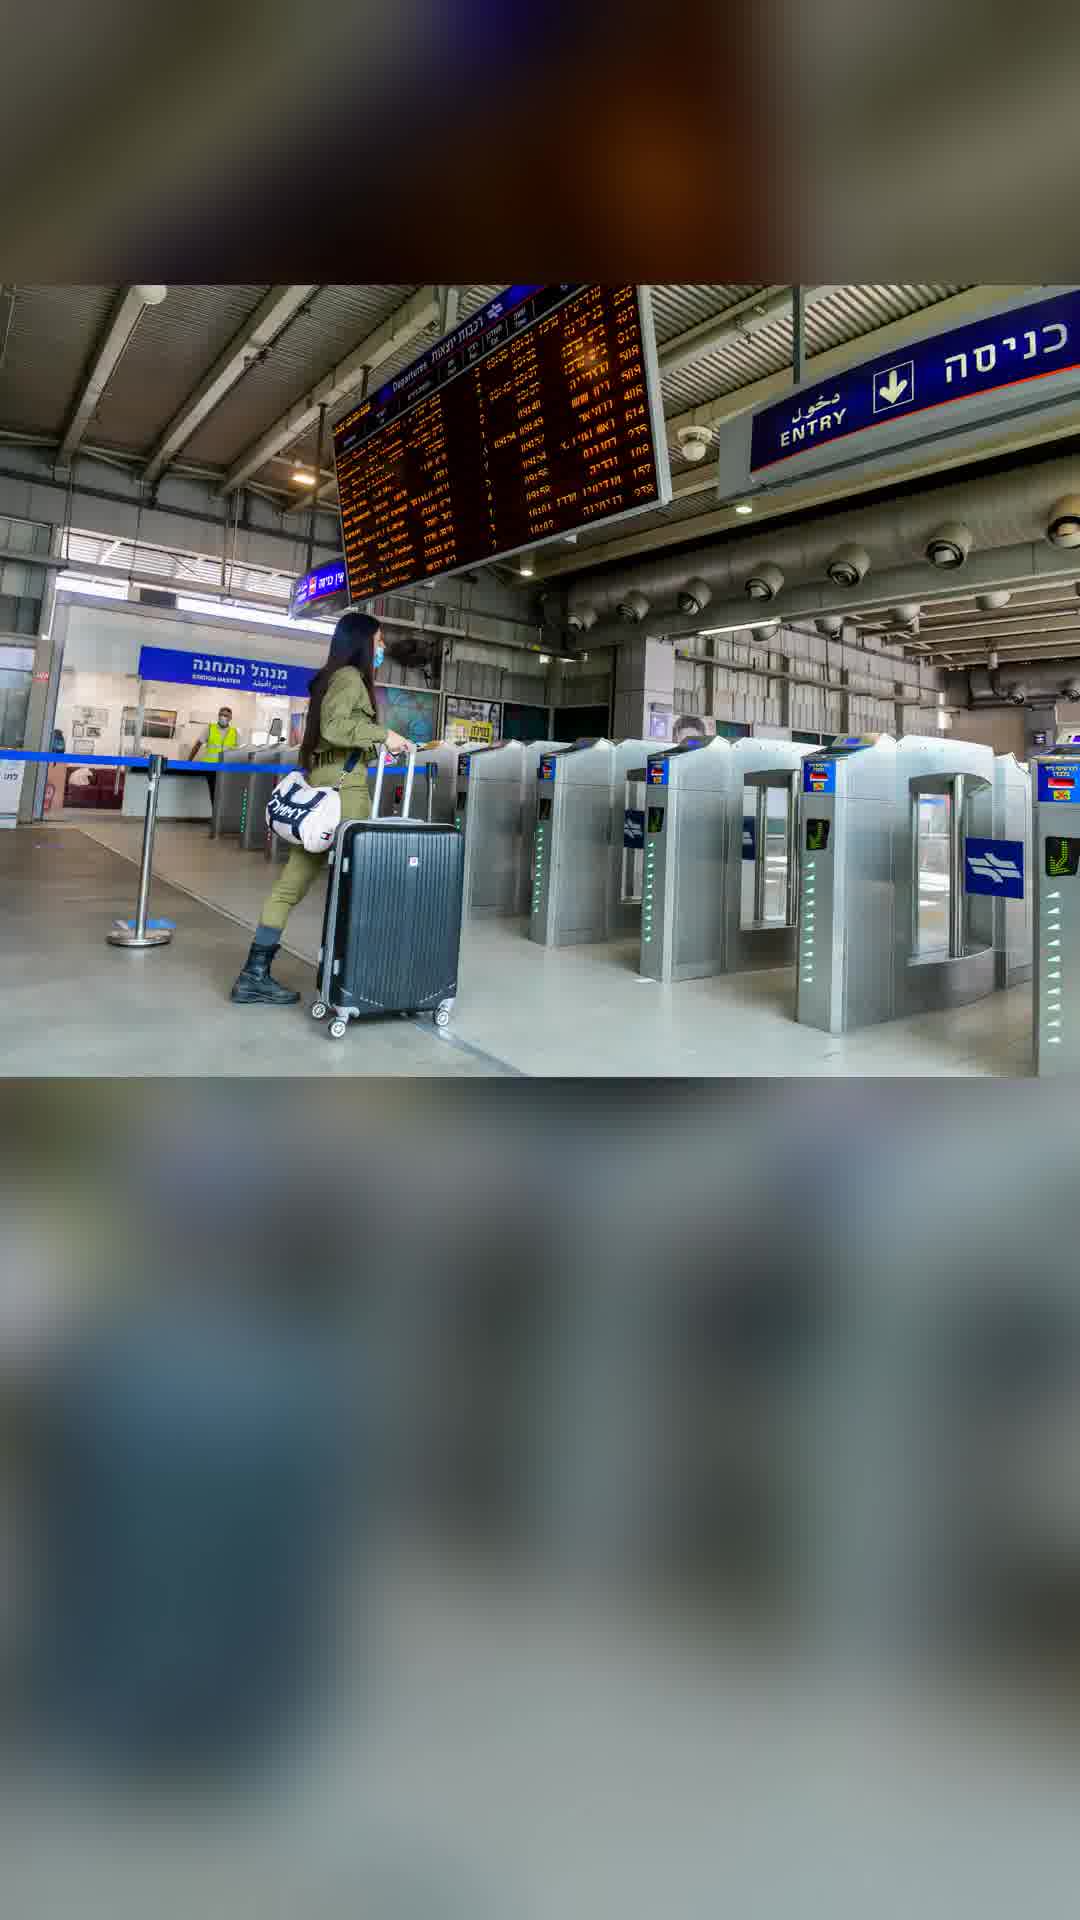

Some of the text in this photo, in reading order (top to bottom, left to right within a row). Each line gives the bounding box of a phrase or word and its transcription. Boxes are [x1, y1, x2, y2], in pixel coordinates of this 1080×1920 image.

[945, 323, 1068, 383] כניסה
[791, 393, 841, 424] دخول
[780, 408, 847, 448] ENTRY
[192, 658, 288, 681] מנהל התחנה
